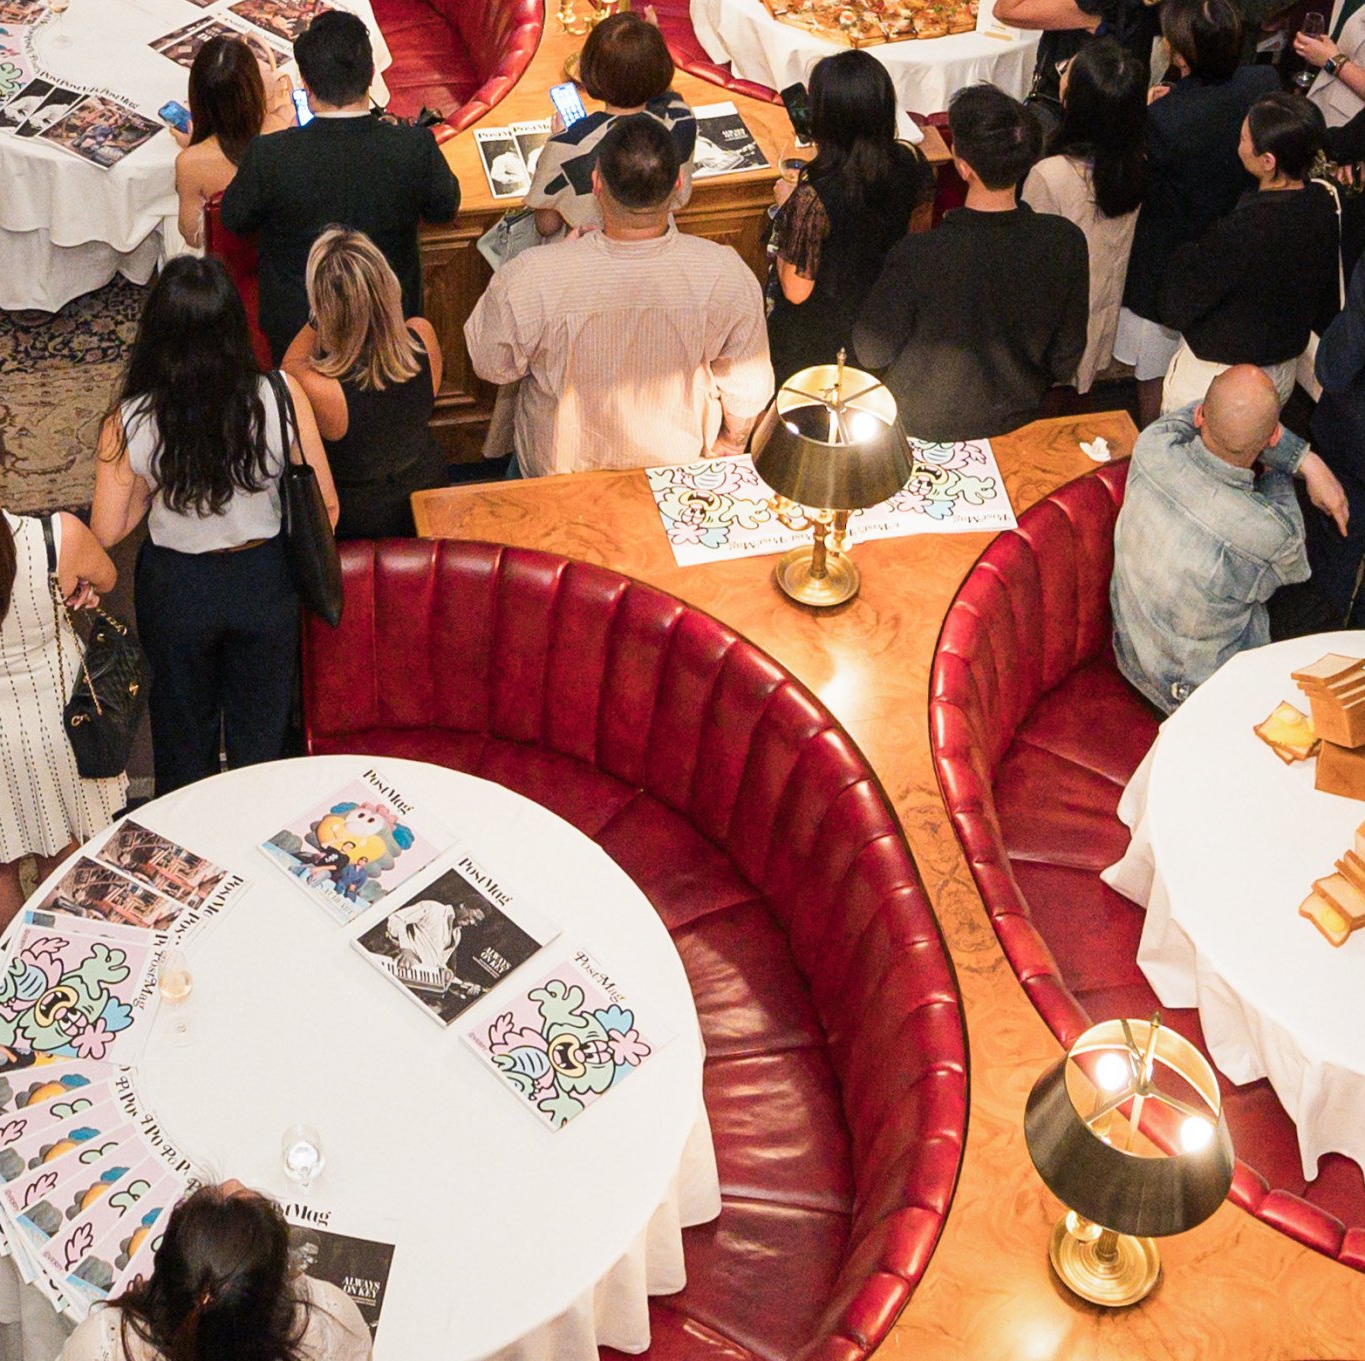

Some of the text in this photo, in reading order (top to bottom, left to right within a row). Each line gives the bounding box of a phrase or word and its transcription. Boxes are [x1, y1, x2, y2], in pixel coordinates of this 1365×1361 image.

[363, 768, 414, 815] PostMag
[458, 857, 513, 906] PostMag
[575, 951, 625, 1003] PostMag
[343, 1276, 381, 1291] ALWAYS
